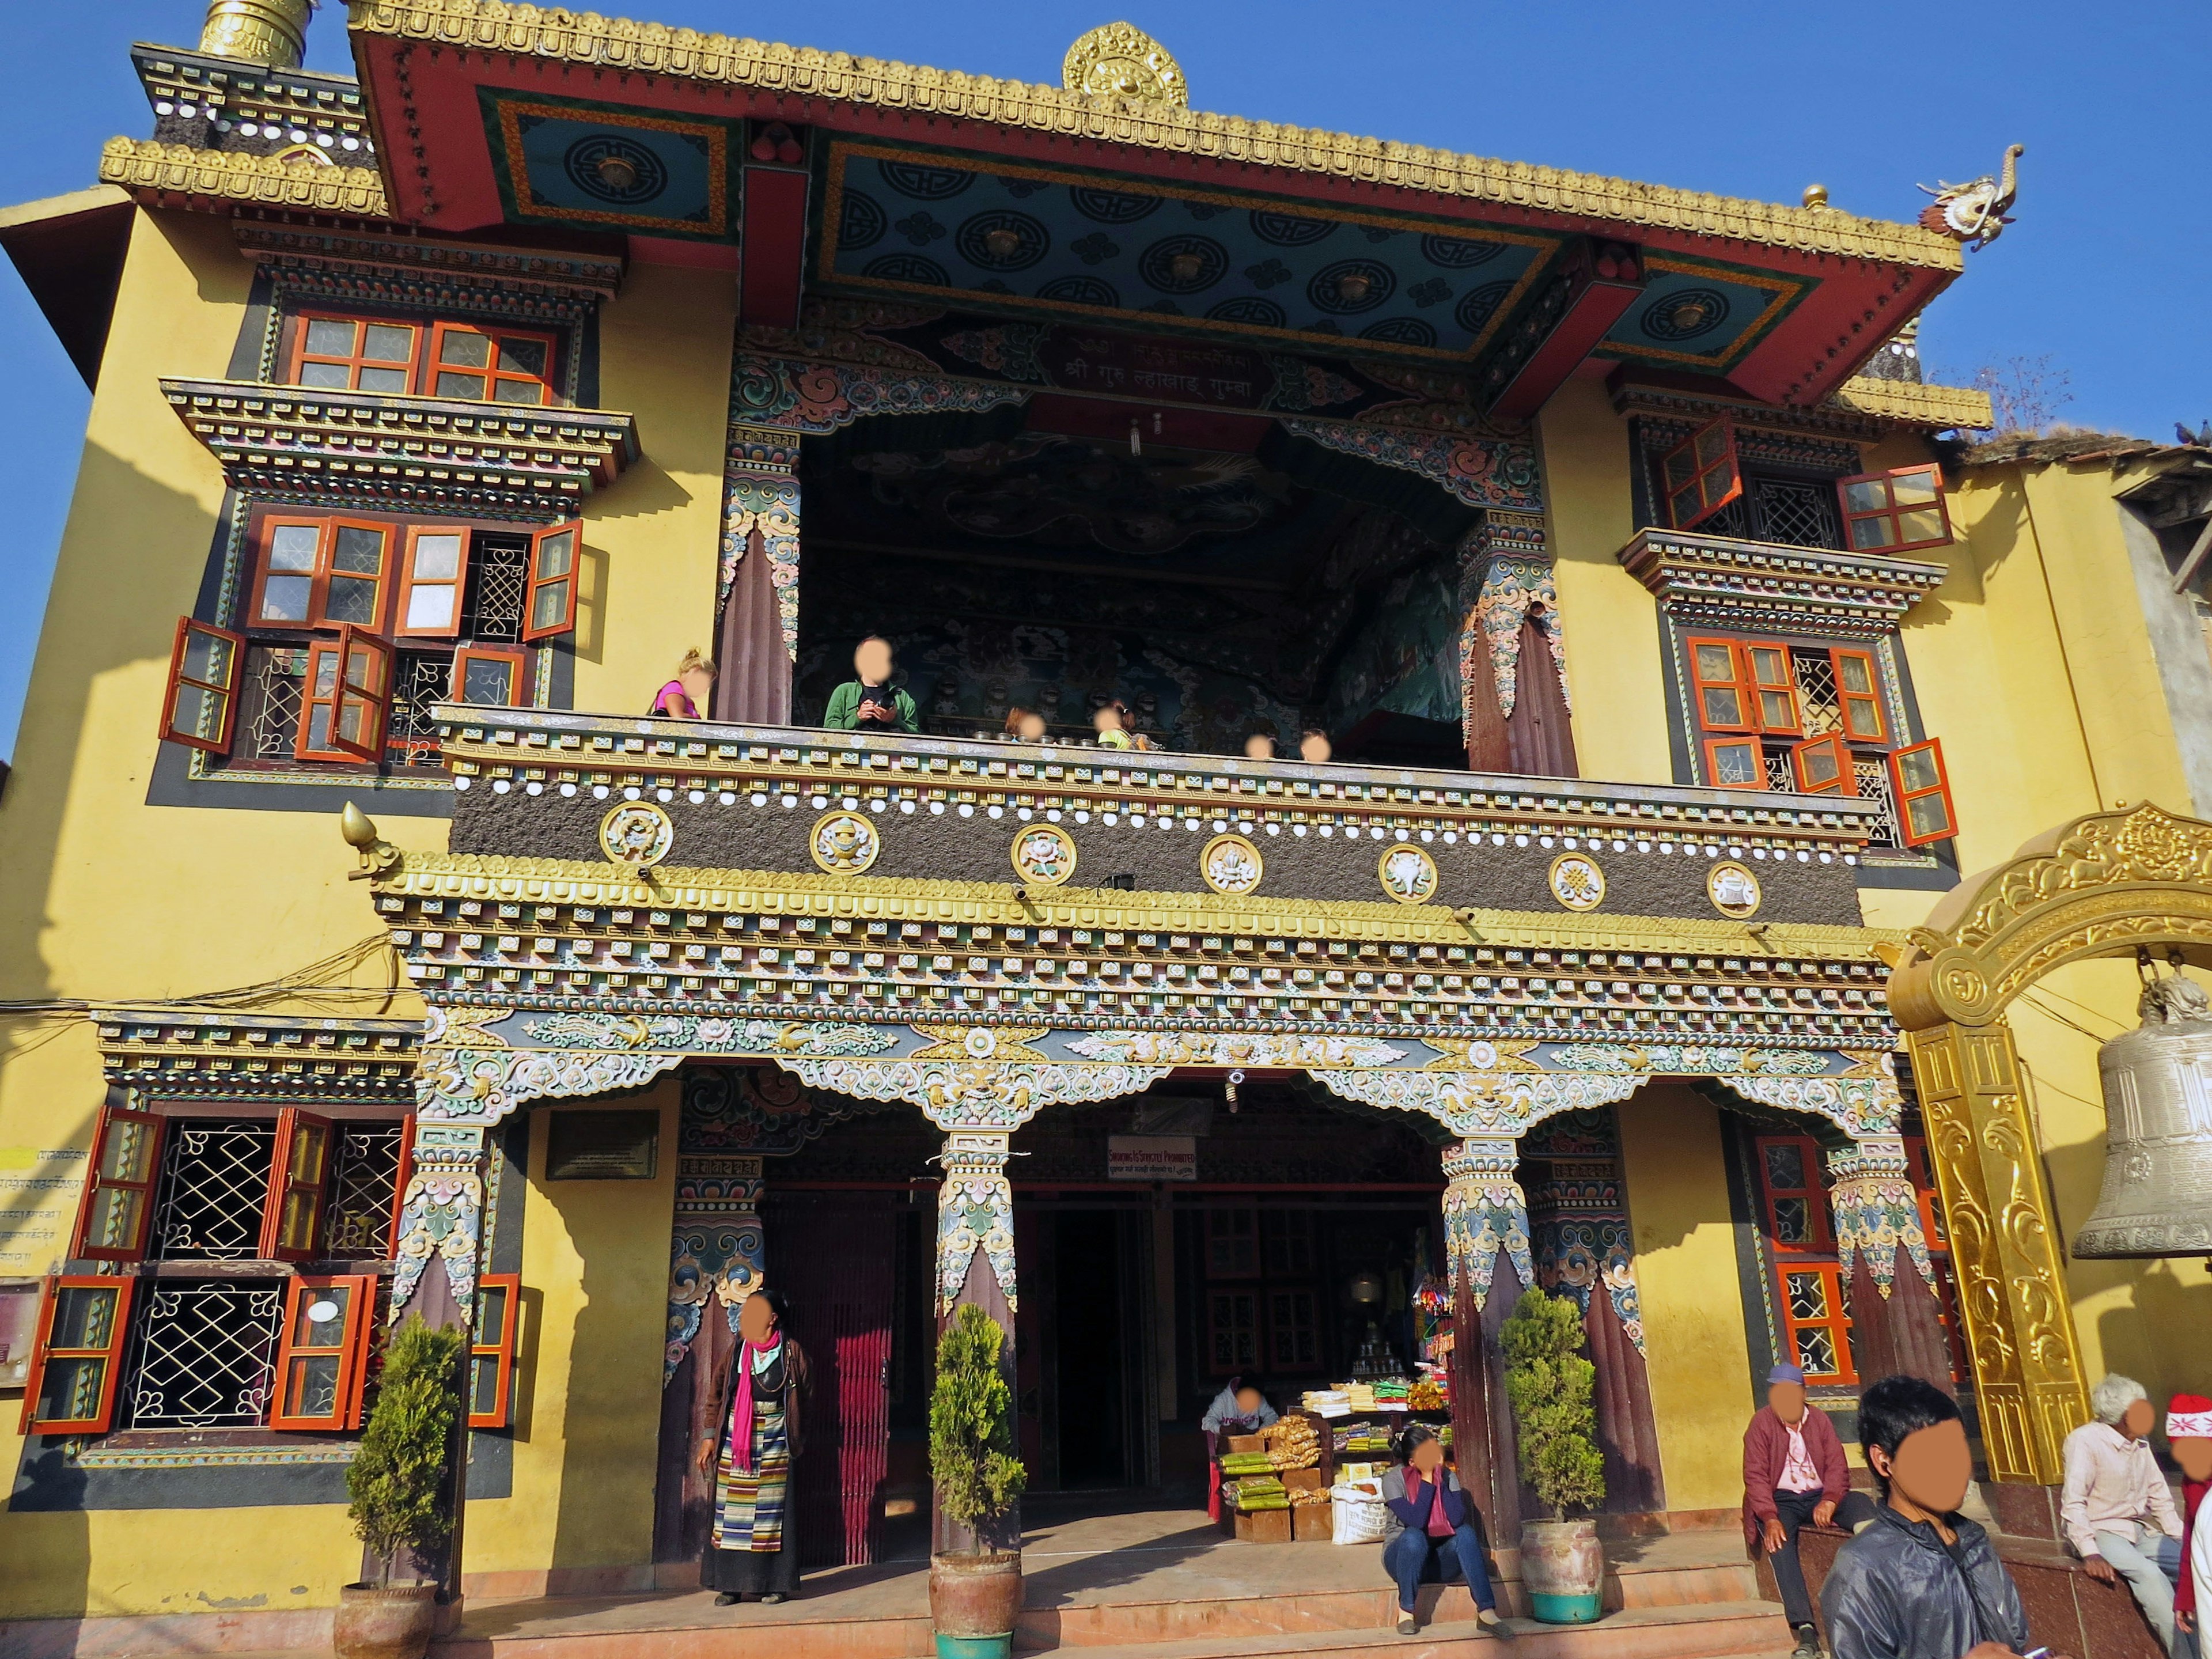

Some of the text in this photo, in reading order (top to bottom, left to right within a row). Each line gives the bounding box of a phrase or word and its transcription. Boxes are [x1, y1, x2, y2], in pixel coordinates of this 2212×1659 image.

[1065, 358, 1089, 378] श्री
[1097, 365, 1125, 388] गुरु
[1208, 378, 1253, 400] गुम्बा
